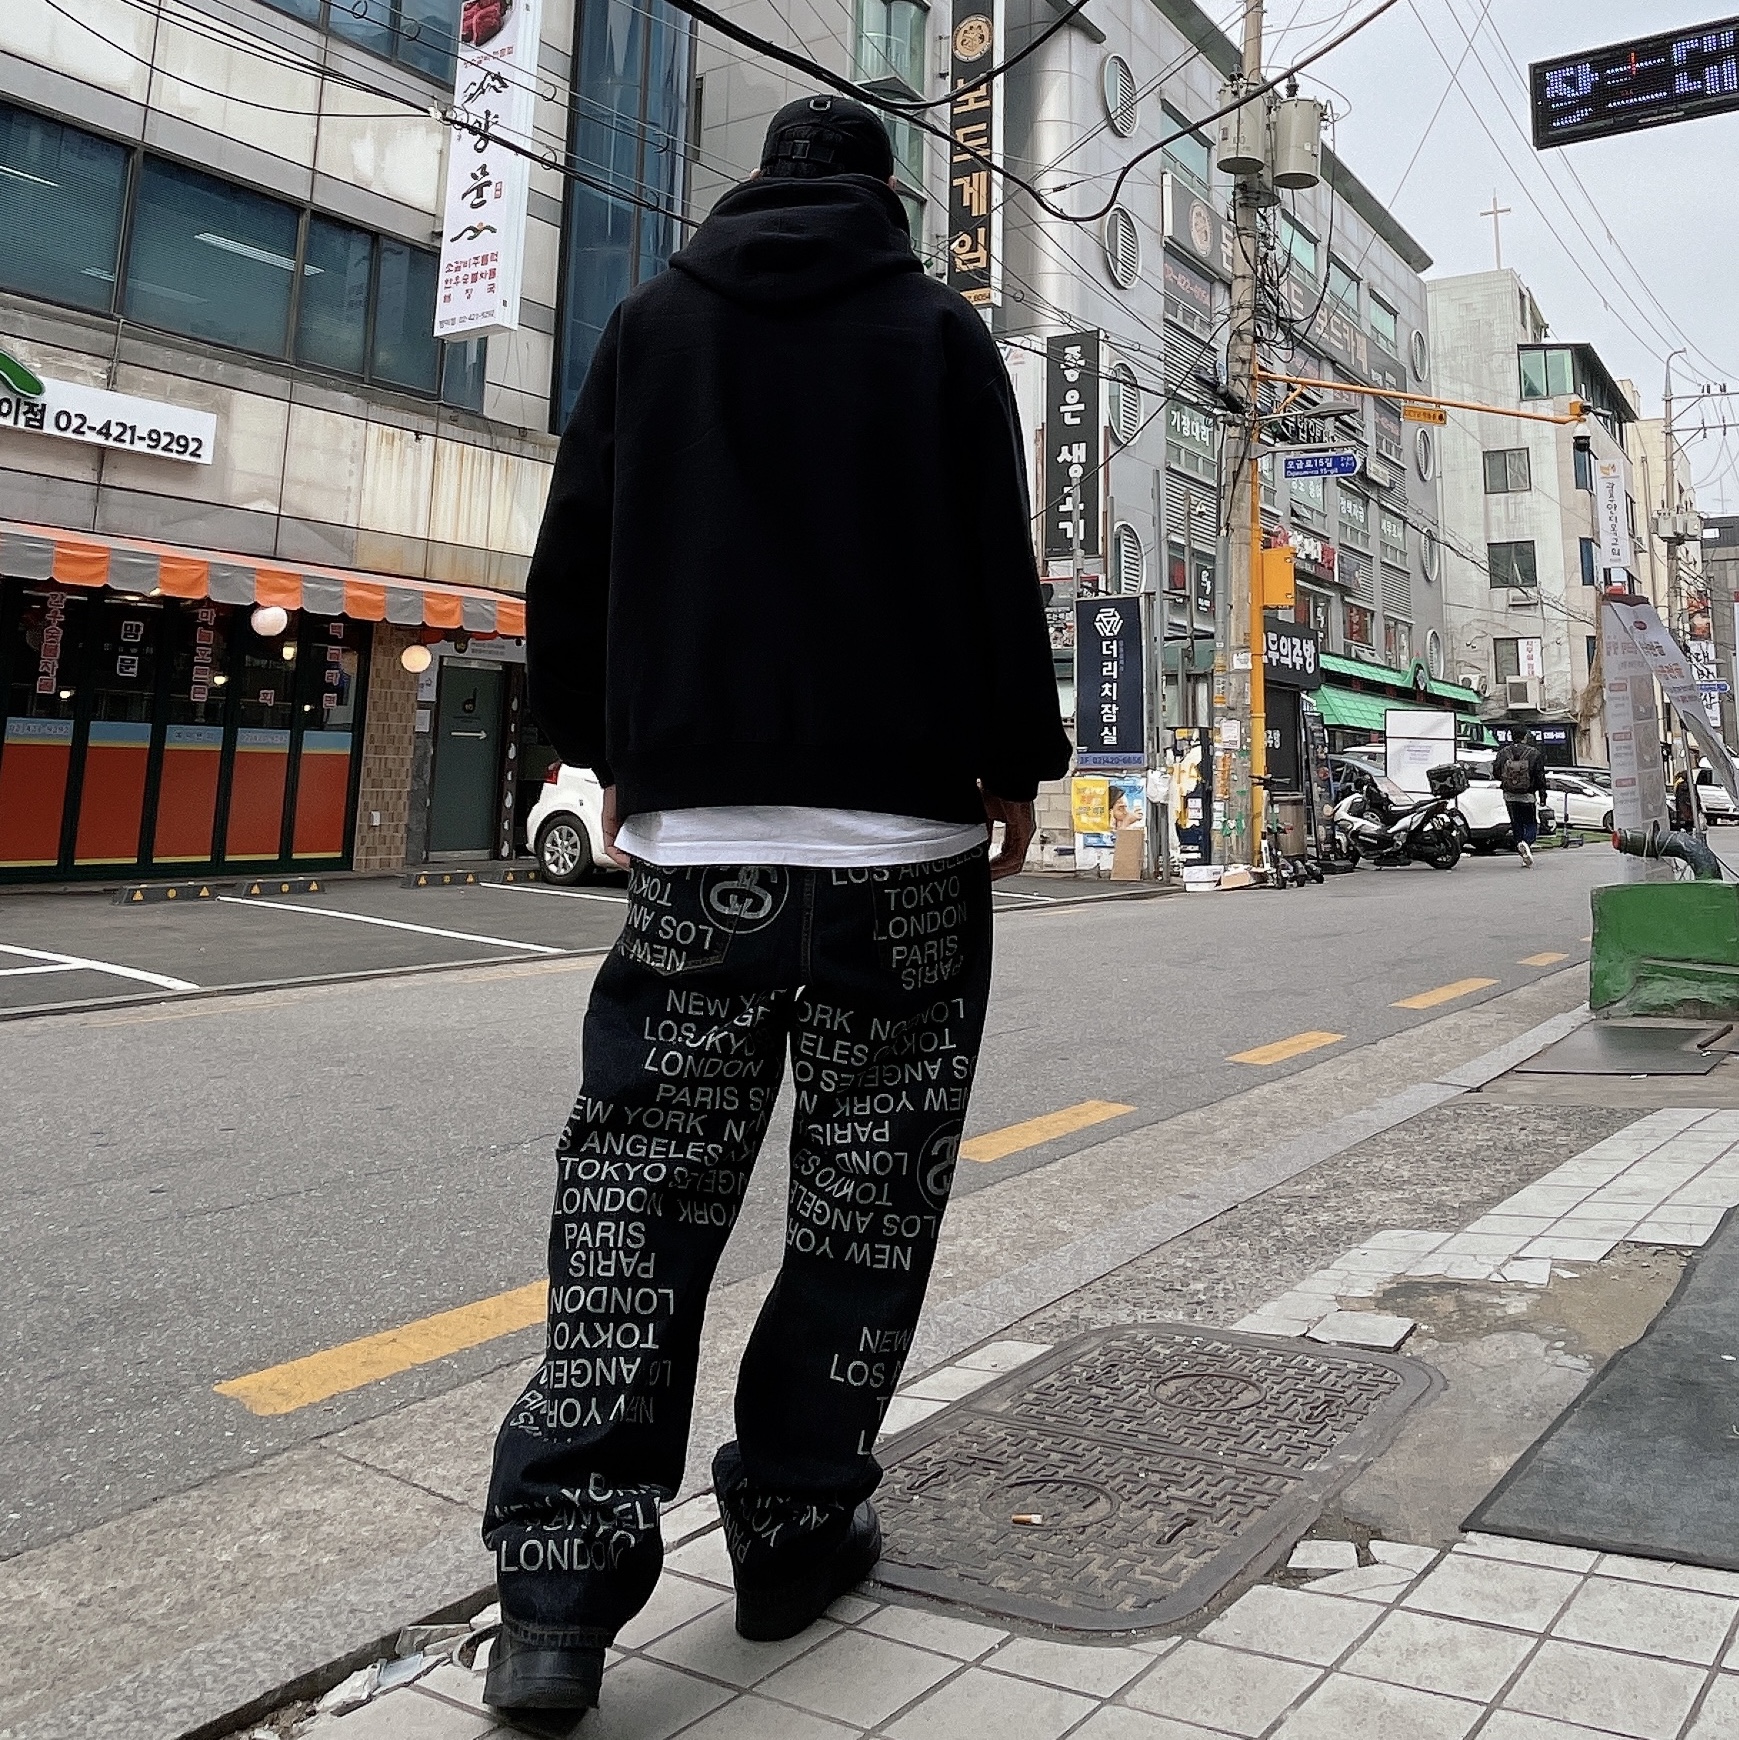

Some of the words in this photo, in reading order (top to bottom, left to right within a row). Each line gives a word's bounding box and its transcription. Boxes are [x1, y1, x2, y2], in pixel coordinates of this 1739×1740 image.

[952, 74, 992, 274] 보드게임
[55, 409, 203, 460] 02-421-9292
[884, 875, 961, 912] TOKYO
[873, 901, 969, 941] LONDON
[892, 936, 959, 969] PARIS
[667, 988, 730, 1019] NEW
[643, 1047, 765, 1080] LONDON
[656, 1083, 736, 1111] PARIS
[624, 1106, 709, 1137] YORK
[580, 1130, 724, 1168] ANGELES
[560, 1155, 668, 1183] TOKYO
[565, 1220, 646, 1250] PARIS
[569, 1250, 656, 1278] PARIS
[845, 1242, 912, 1272] NEW
[550, 1286, 674, 1315] LONDON
[830, 1353, 885, 1388] LOS
